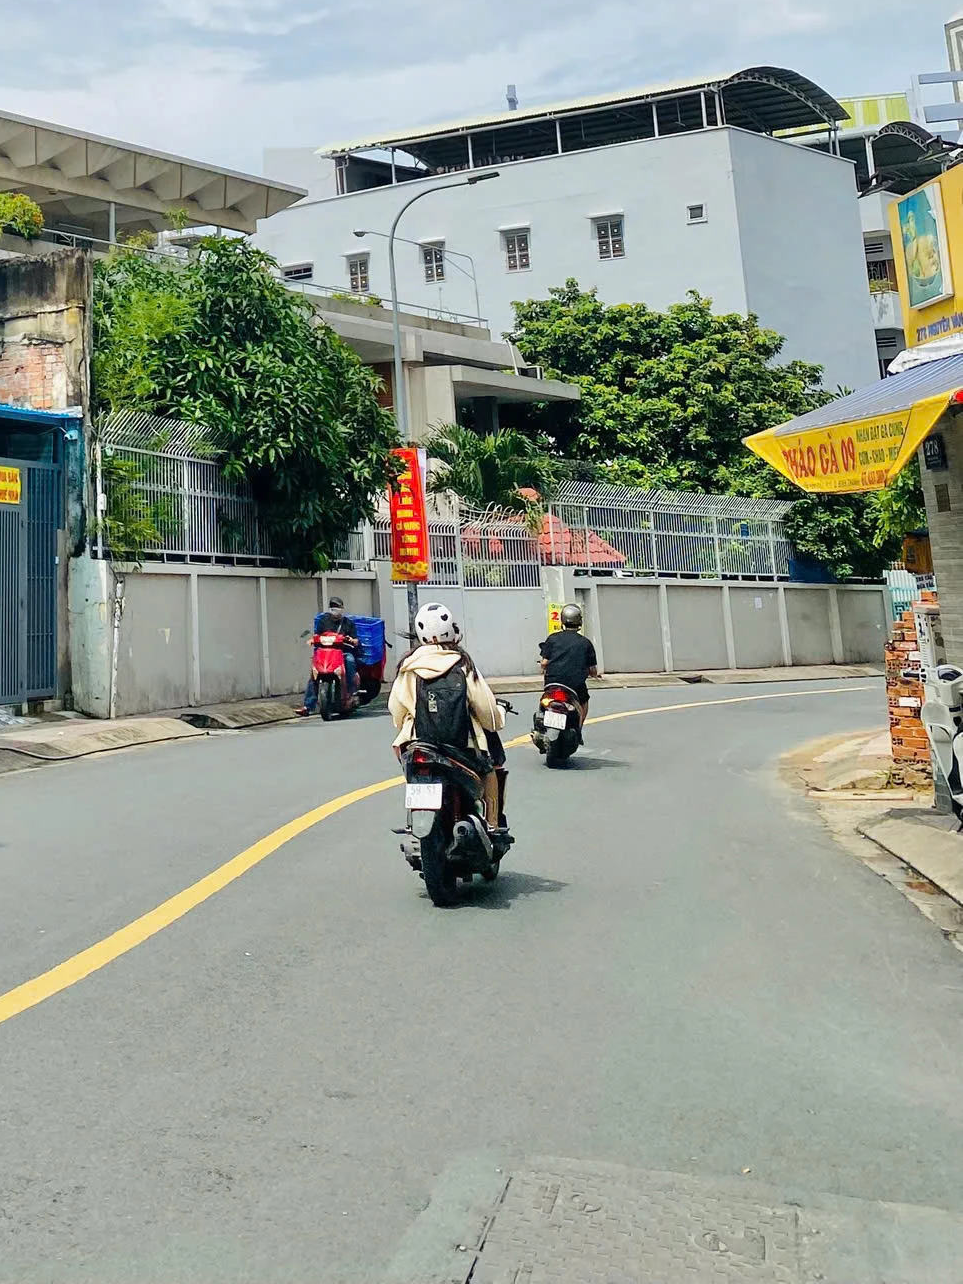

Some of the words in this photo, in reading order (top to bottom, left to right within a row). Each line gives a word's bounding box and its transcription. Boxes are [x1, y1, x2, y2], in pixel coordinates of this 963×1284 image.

[819, 432, 840, 475] GÀ
[841, 436, 855, 472] 09
[925, 440, 939, 455] 278
